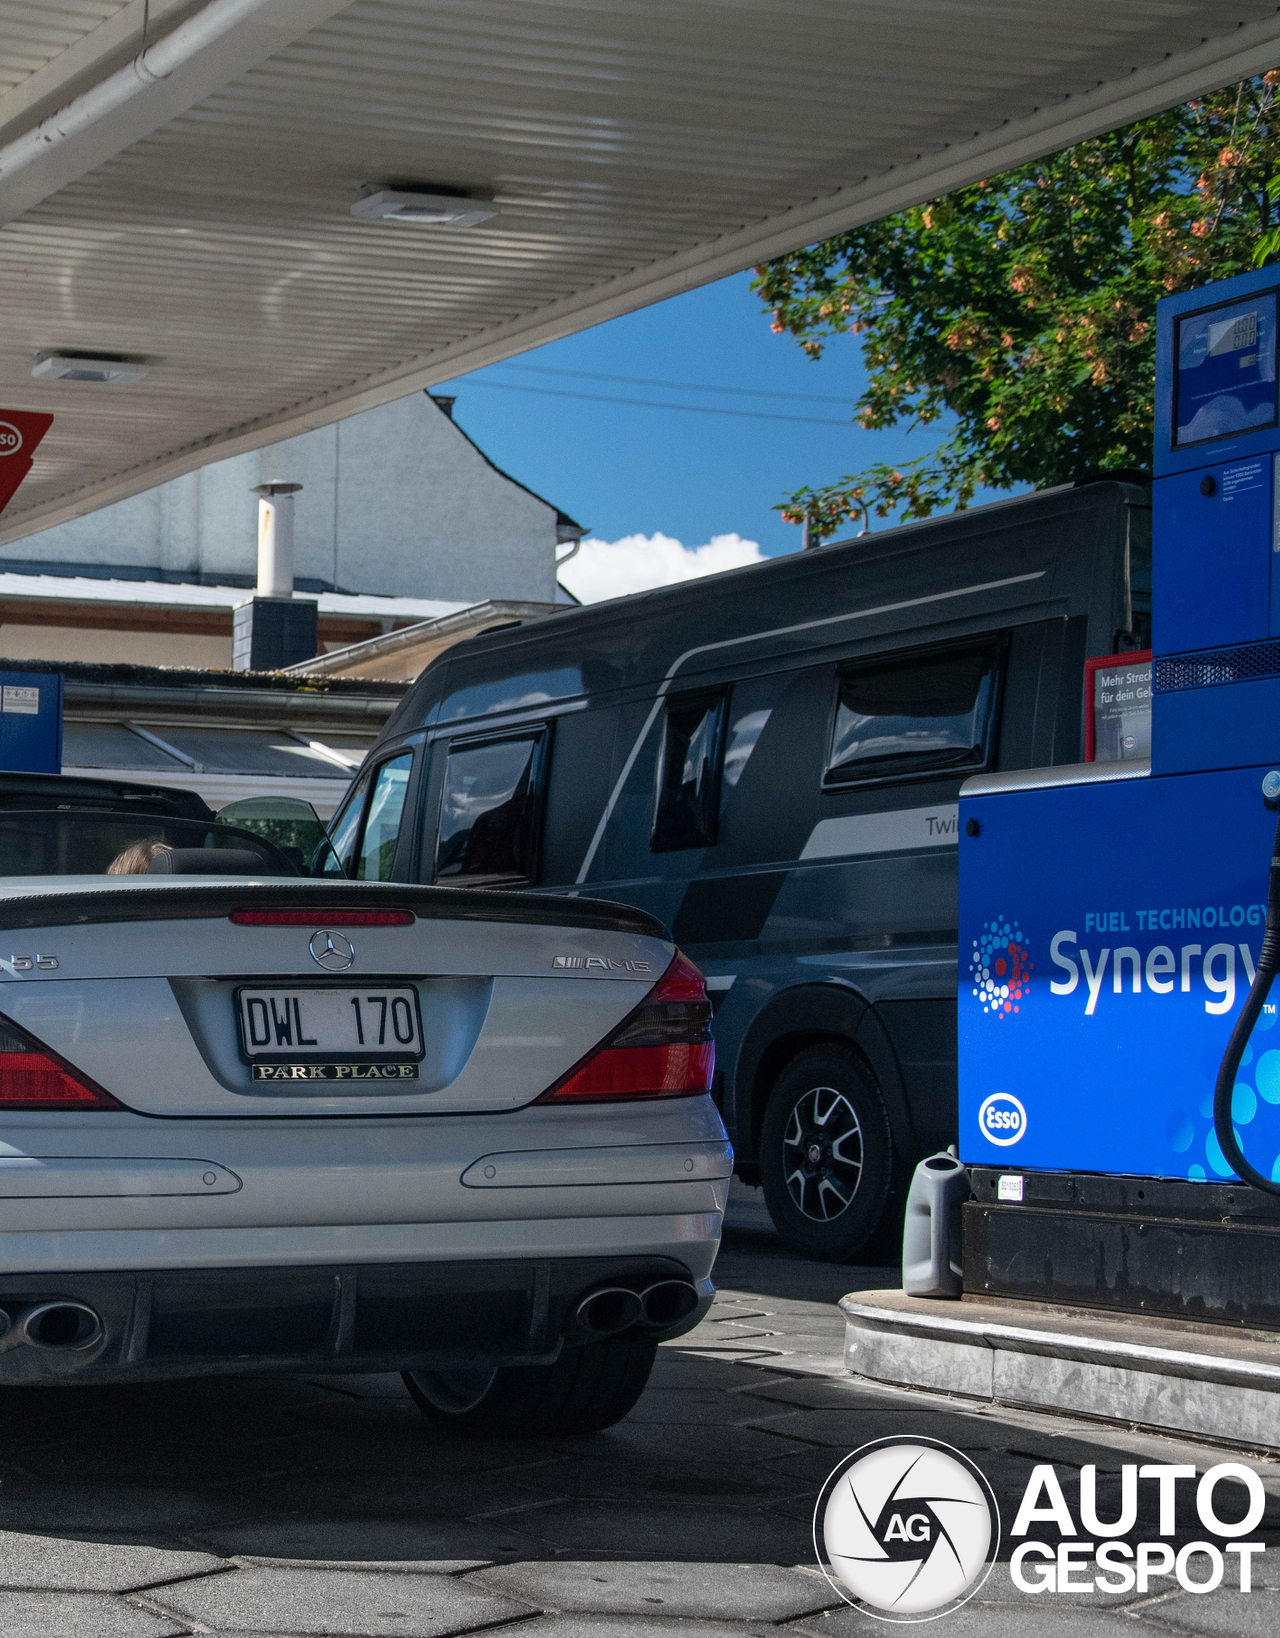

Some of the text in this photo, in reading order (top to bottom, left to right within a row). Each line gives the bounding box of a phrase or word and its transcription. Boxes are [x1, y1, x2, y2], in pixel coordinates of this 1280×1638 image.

[1101, 674, 1125, 687] Mehr
[1101, 686, 1153, 703] für dein Gel
[925, 814, 959, 836] Twi
[1085, 911, 1130, 933] FUEL
[11, 953, 59, 971] 55
[585, 957, 652, 972] AMG
[246, 996, 415, 1046] DWL 170
[258, 1064, 415, 1079] PARK PLACE
[986, 1106, 1020, 1129] Esso
